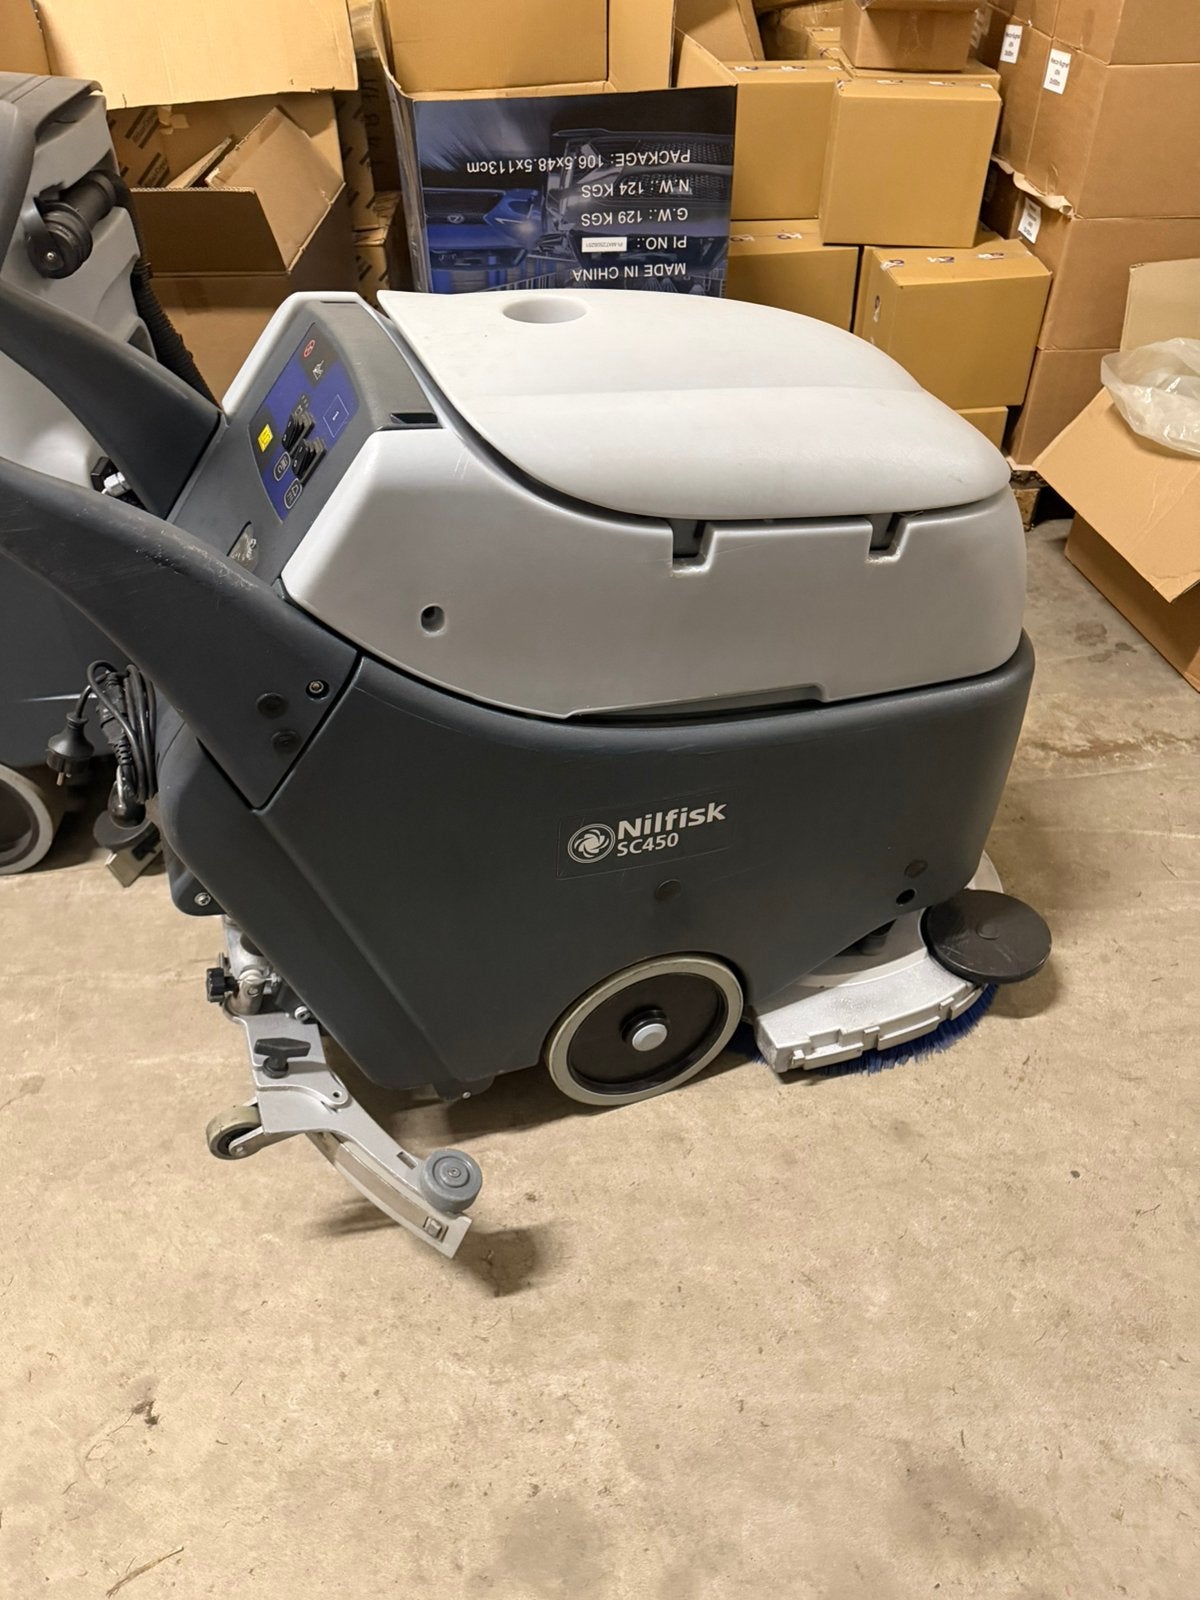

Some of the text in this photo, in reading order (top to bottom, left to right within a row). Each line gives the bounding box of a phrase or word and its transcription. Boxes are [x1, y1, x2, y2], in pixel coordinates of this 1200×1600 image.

[466, 149, 691, 175] PACKAGE: 106.5x48.5x113cm
[581, 178, 690, 198] N.W.: 124 KGS
[581, 207, 689, 227] G.W.: 129 KGS
[637, 235, 687, 250] PI NO.:
[572, 262, 687, 281] MADE IN CHINA
[617, 802, 727, 840] Nilfisk
[616, 832, 679, 857] SC450
